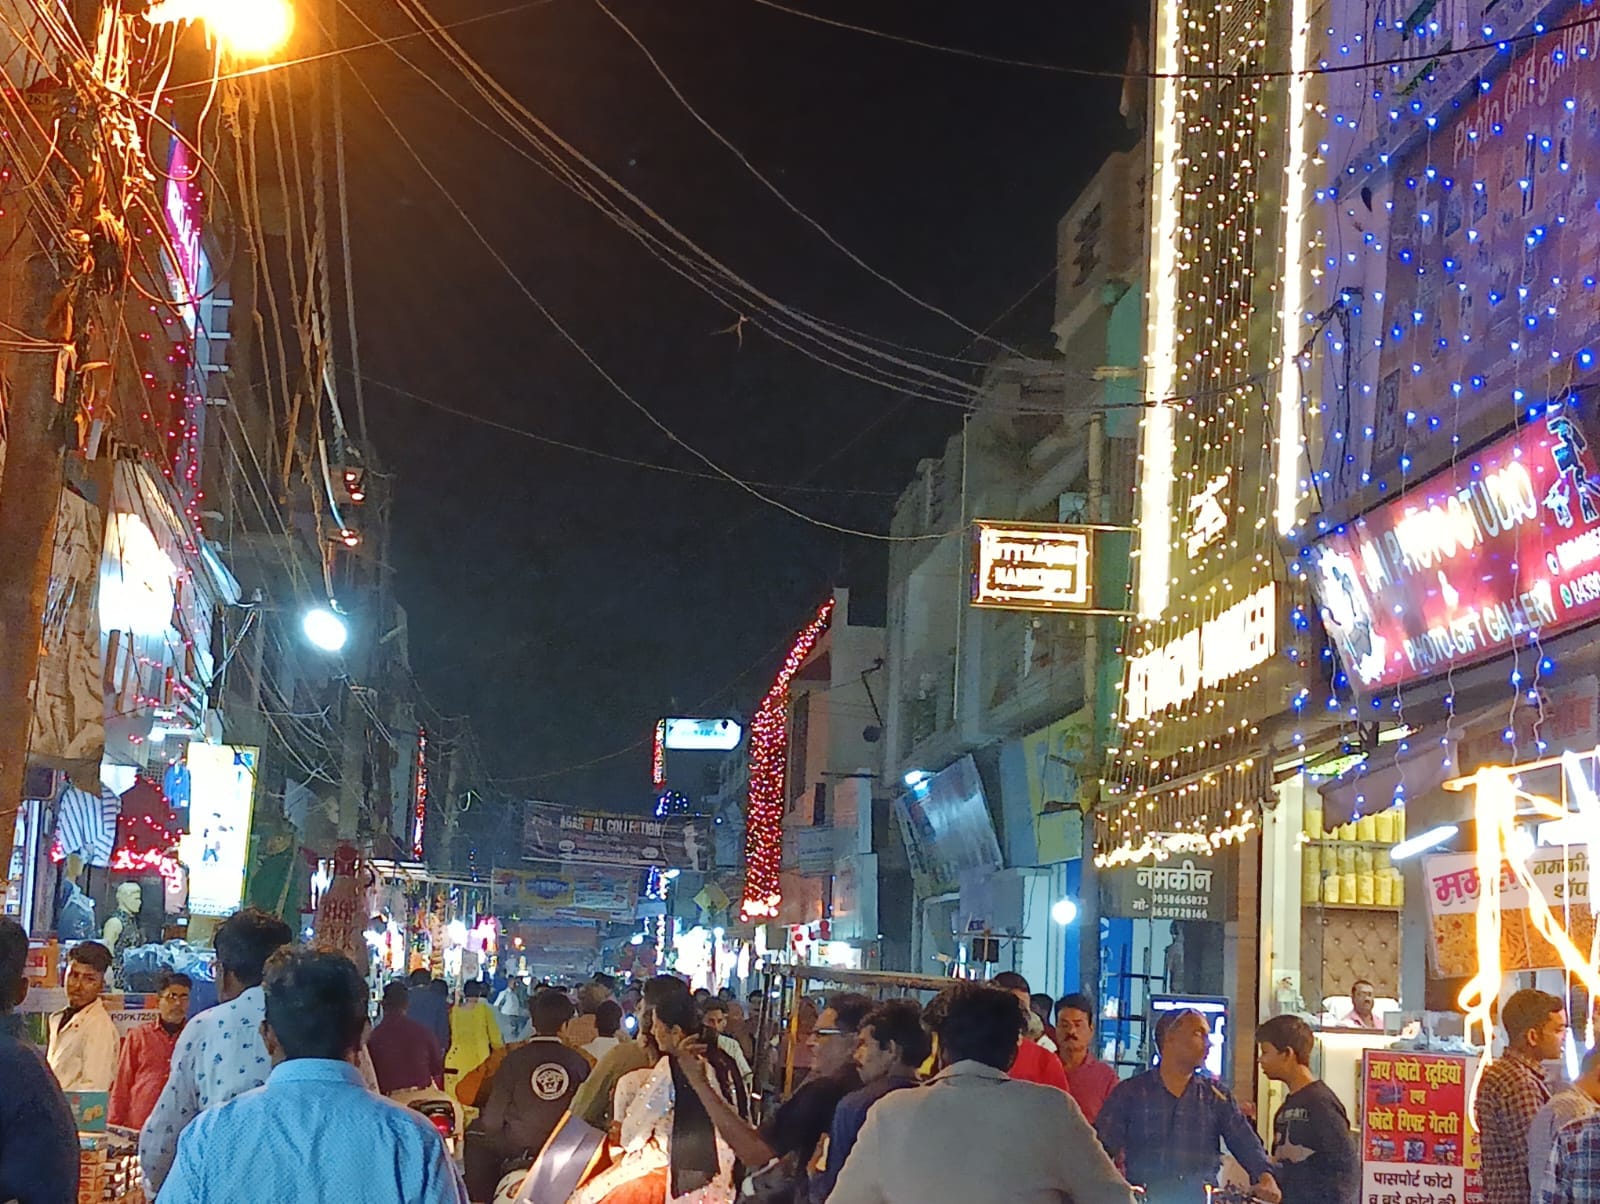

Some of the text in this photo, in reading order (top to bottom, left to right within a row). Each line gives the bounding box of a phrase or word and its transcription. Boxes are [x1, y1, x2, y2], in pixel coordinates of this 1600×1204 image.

[1447, 461, 1537, 552] STUDIO
[1482, 580, 1558, 642] GALLERY
[1136, 859, 1213, 892] नमकीन
[1370, 1060, 1391, 1080] जय
[1395, 1057, 1420, 1082] फोटो
[1368, 1107, 1394, 1130] फोटो
[1374, 1169, 1420, 1187] पासपोर्ट
[1424, 1171, 1453, 1189] फोटो
